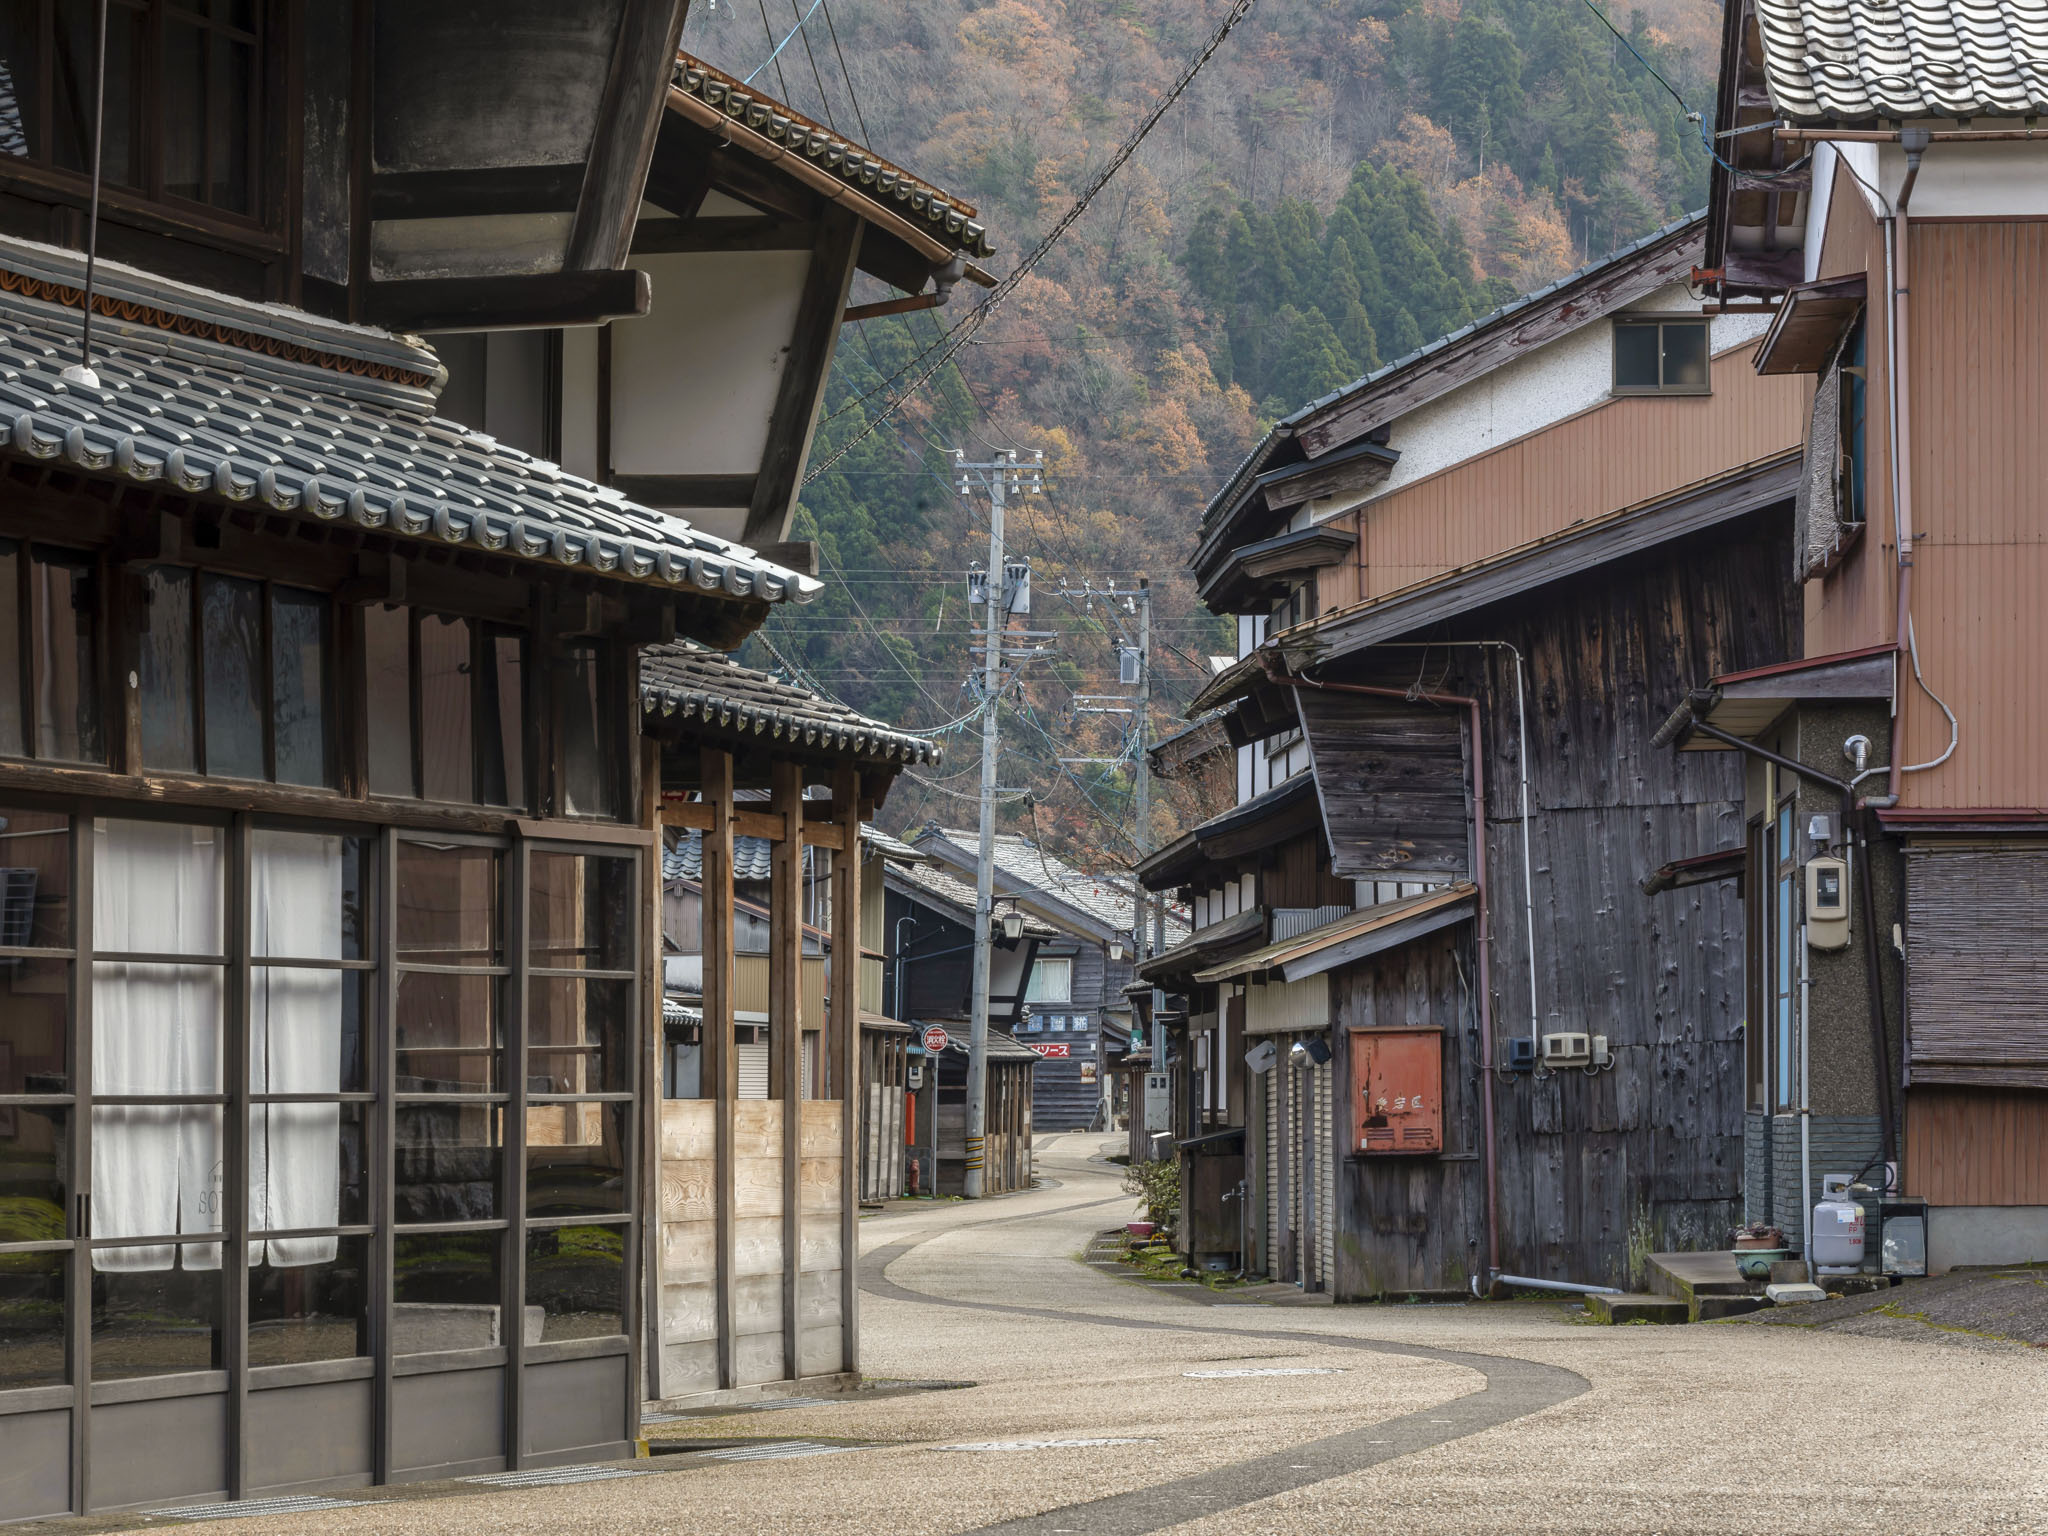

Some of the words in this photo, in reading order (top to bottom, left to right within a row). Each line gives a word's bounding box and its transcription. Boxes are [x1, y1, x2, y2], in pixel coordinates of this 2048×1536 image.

[926, 1034, 944, 1044] 消火栓
[199, 1190, 222, 1214] SO
